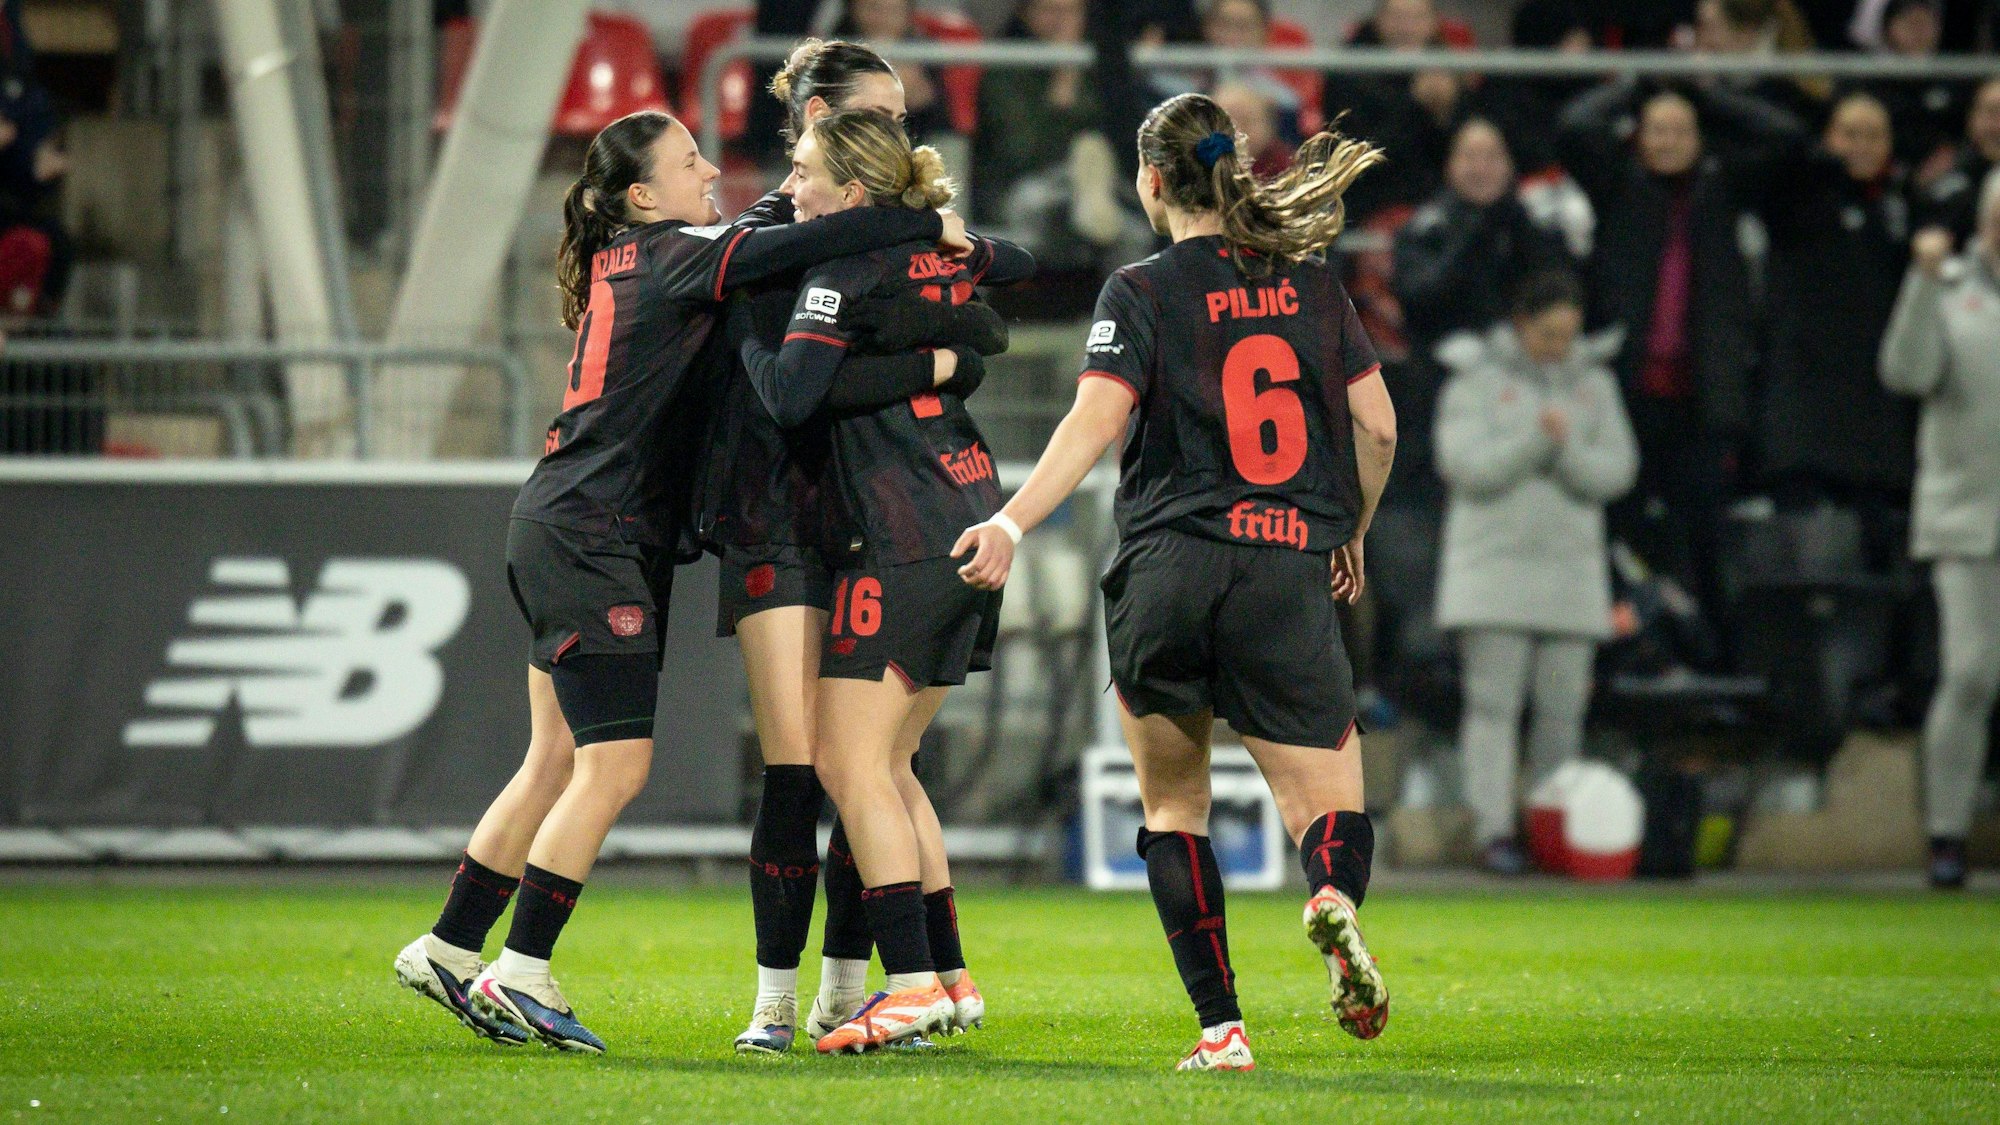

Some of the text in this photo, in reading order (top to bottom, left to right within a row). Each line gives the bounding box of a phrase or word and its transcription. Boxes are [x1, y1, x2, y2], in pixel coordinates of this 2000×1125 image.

[1206, 277, 1300, 323] PILJIĆ
[1222, 333, 1307, 486] 6
[1226, 500, 1309, 551] früh
[831, 576, 883, 636] 16
[123, 558, 471, 747] NB
